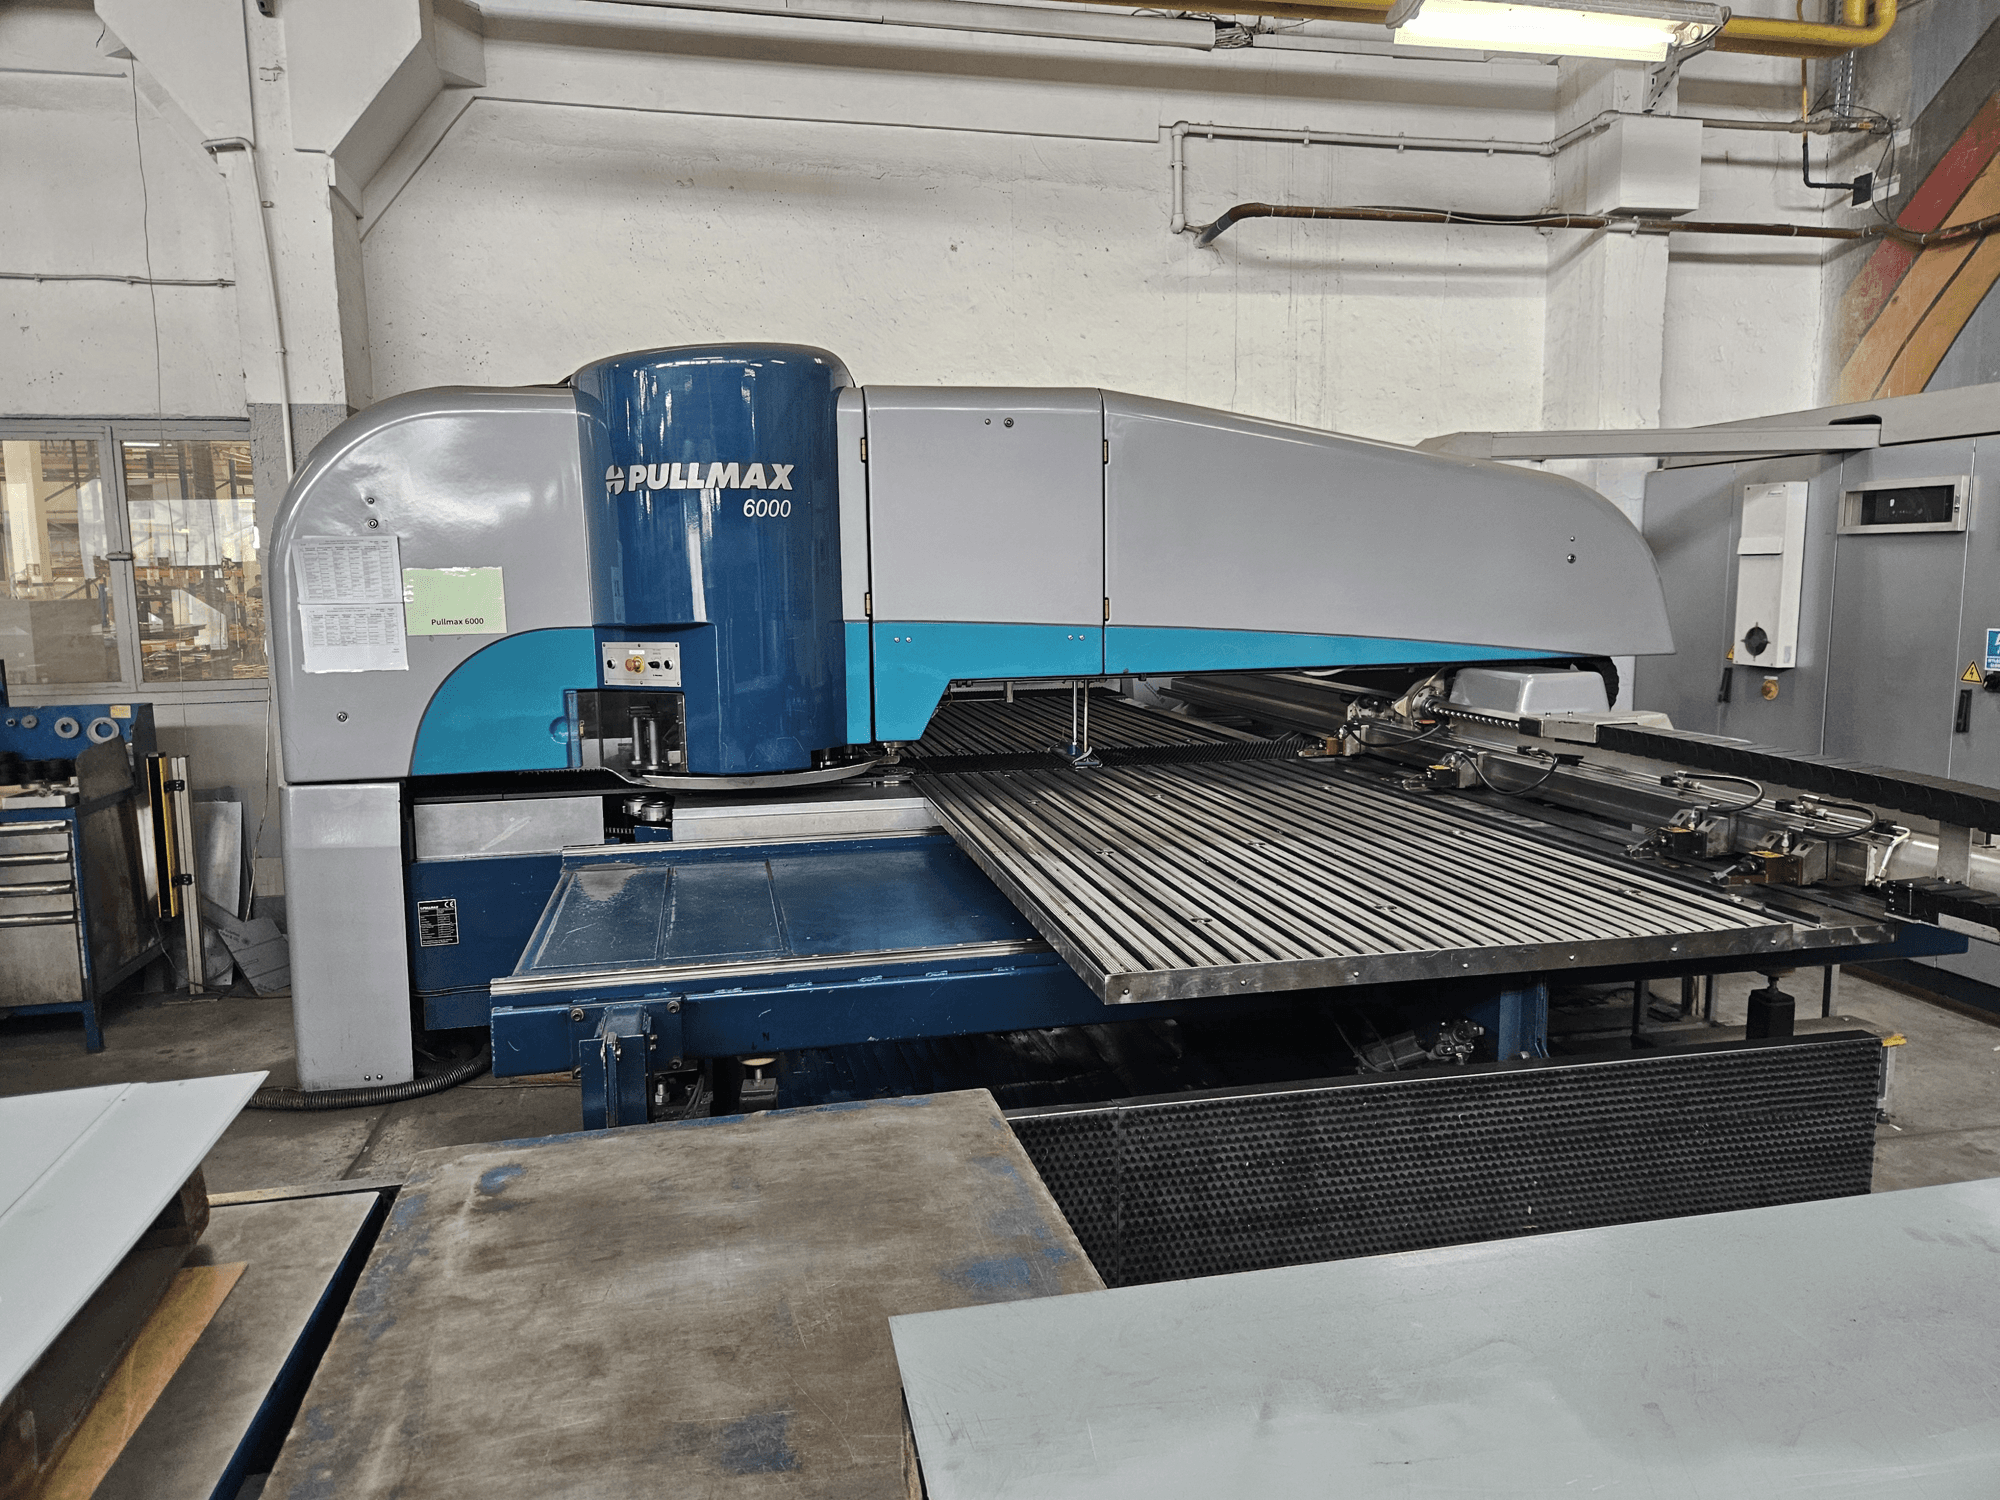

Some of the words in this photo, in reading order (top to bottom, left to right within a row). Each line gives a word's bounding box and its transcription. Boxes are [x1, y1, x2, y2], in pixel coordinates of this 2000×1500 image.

[628, 462, 794, 491] PULLMAX
[743, 499, 791, 518] 6000
[431, 618, 463, 626] Pullmax
[464, 617, 484, 625] 6000
